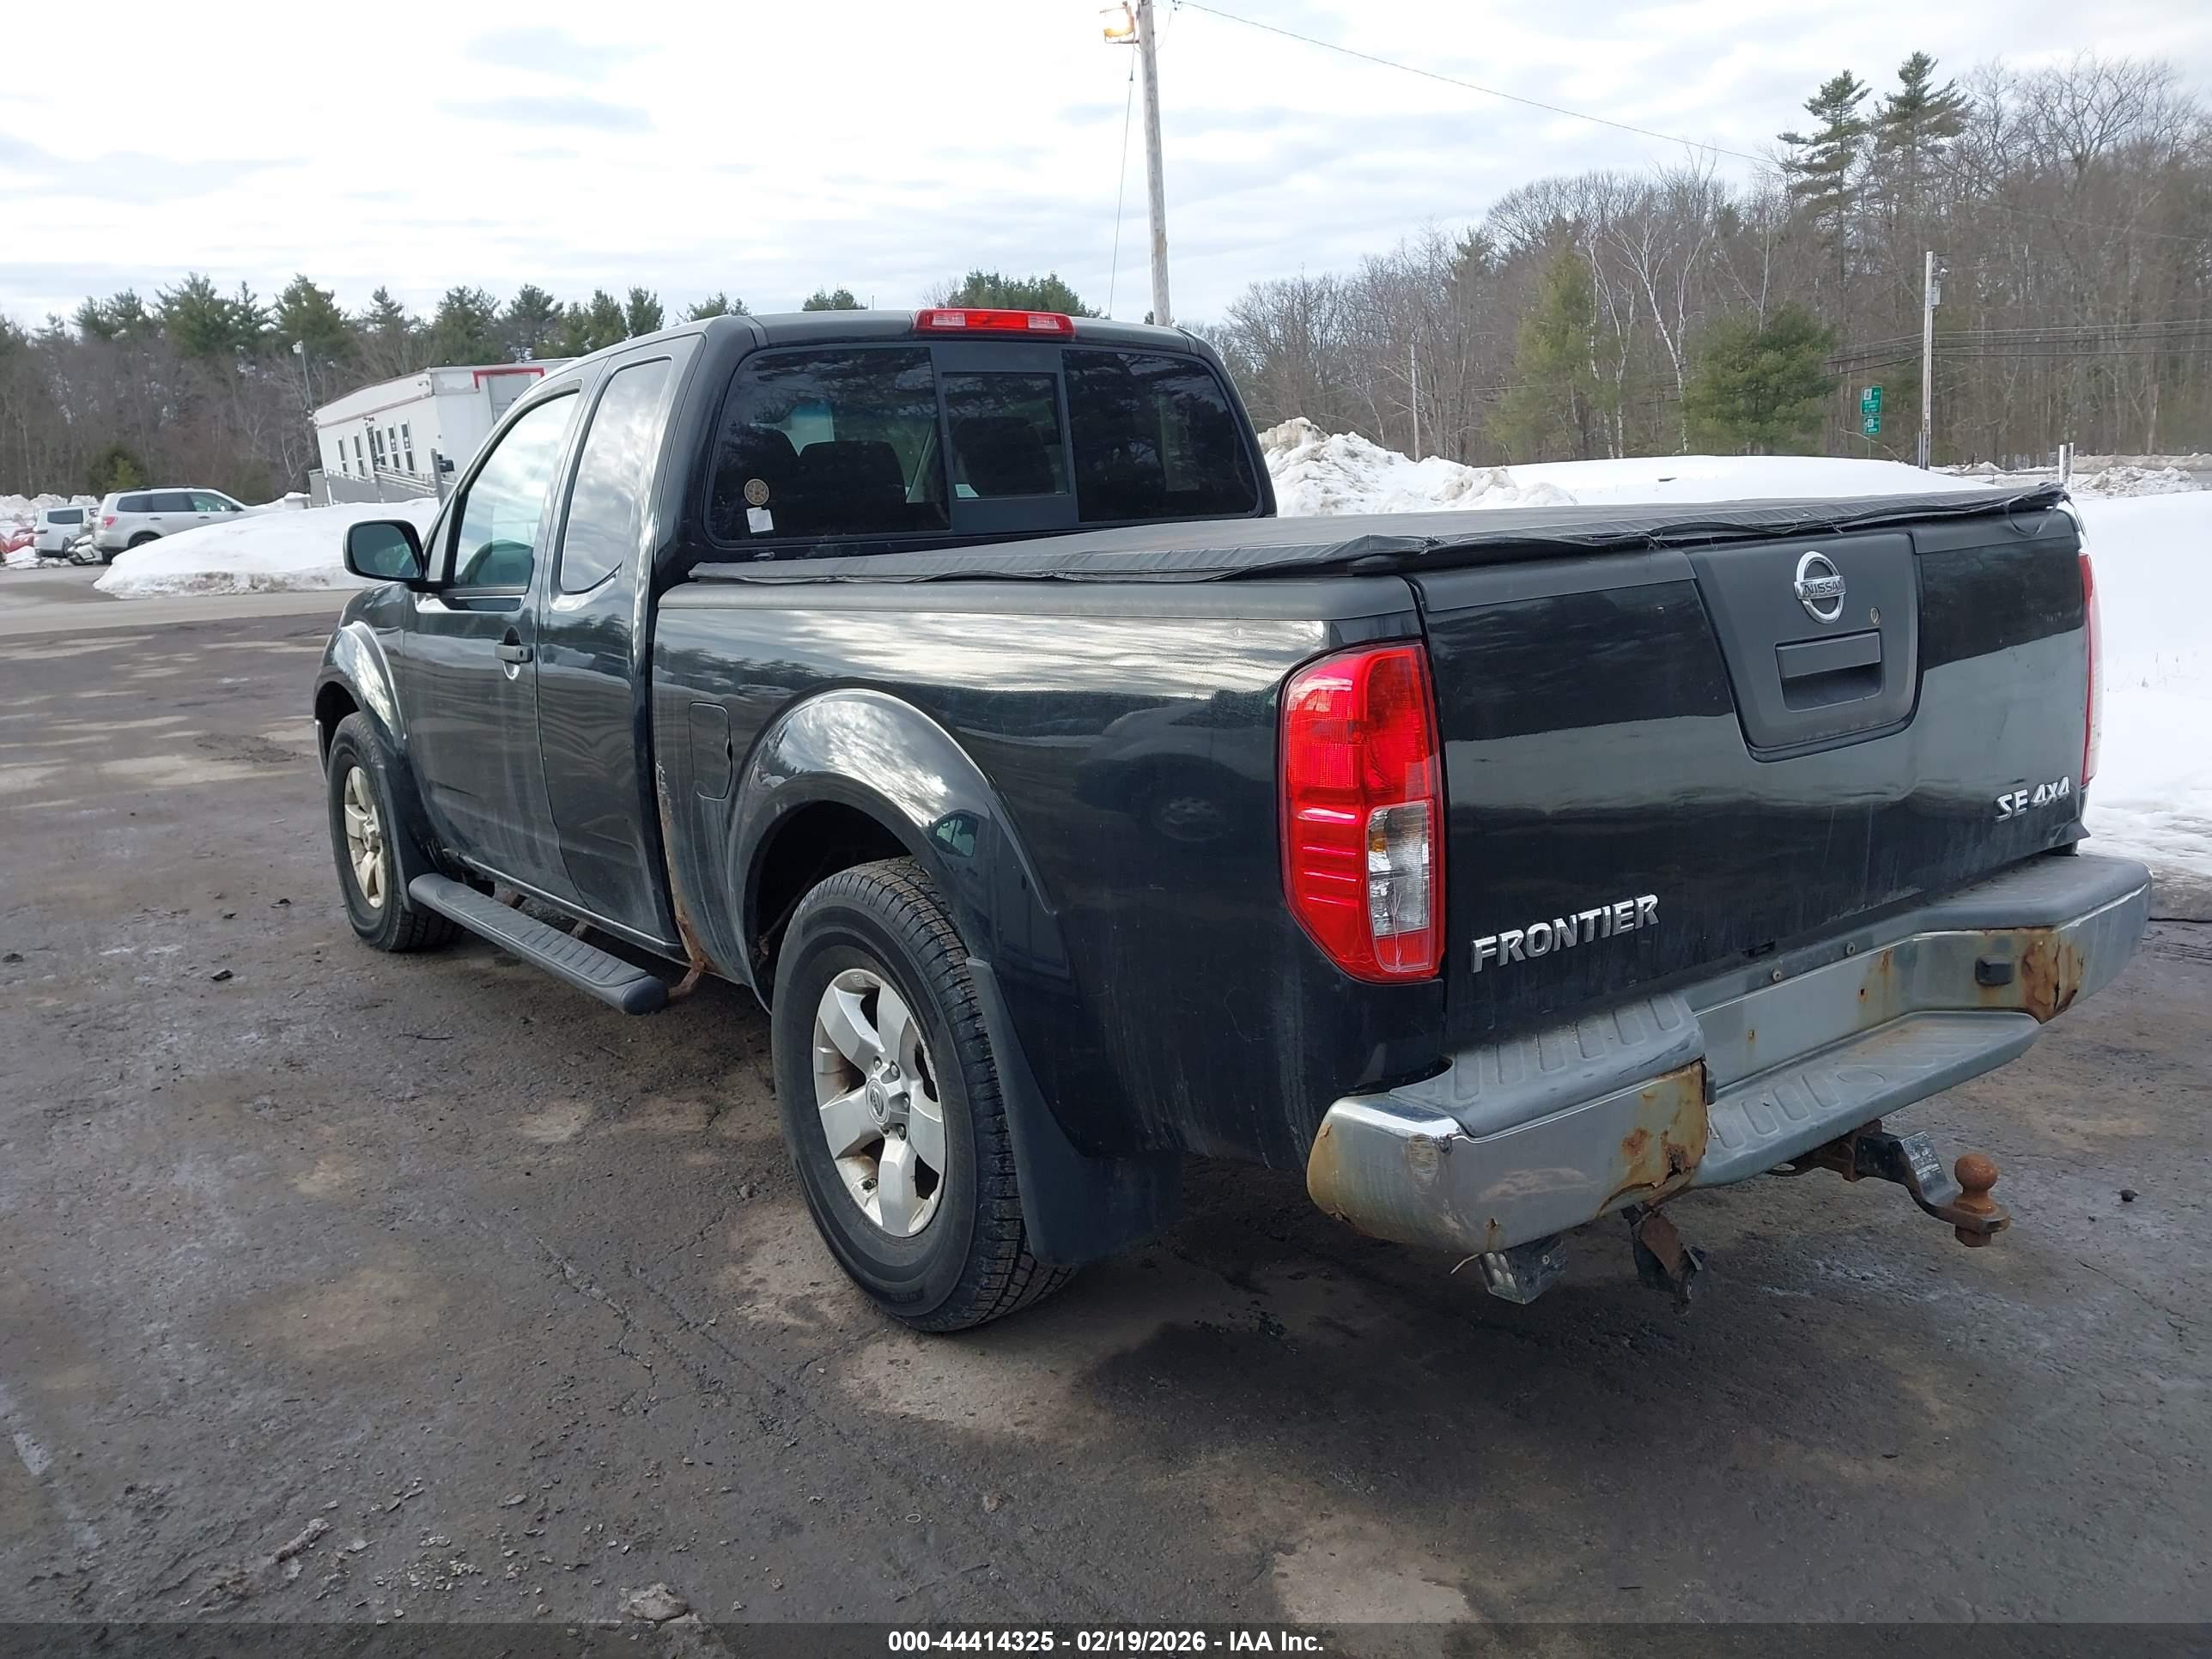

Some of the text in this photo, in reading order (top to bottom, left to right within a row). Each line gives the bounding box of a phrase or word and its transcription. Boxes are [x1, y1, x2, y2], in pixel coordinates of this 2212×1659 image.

[1803, 580, 1844, 595] NISSAN
[1995, 788, 2028, 823] SE
[1472, 894, 1659, 974] FRONTIER
